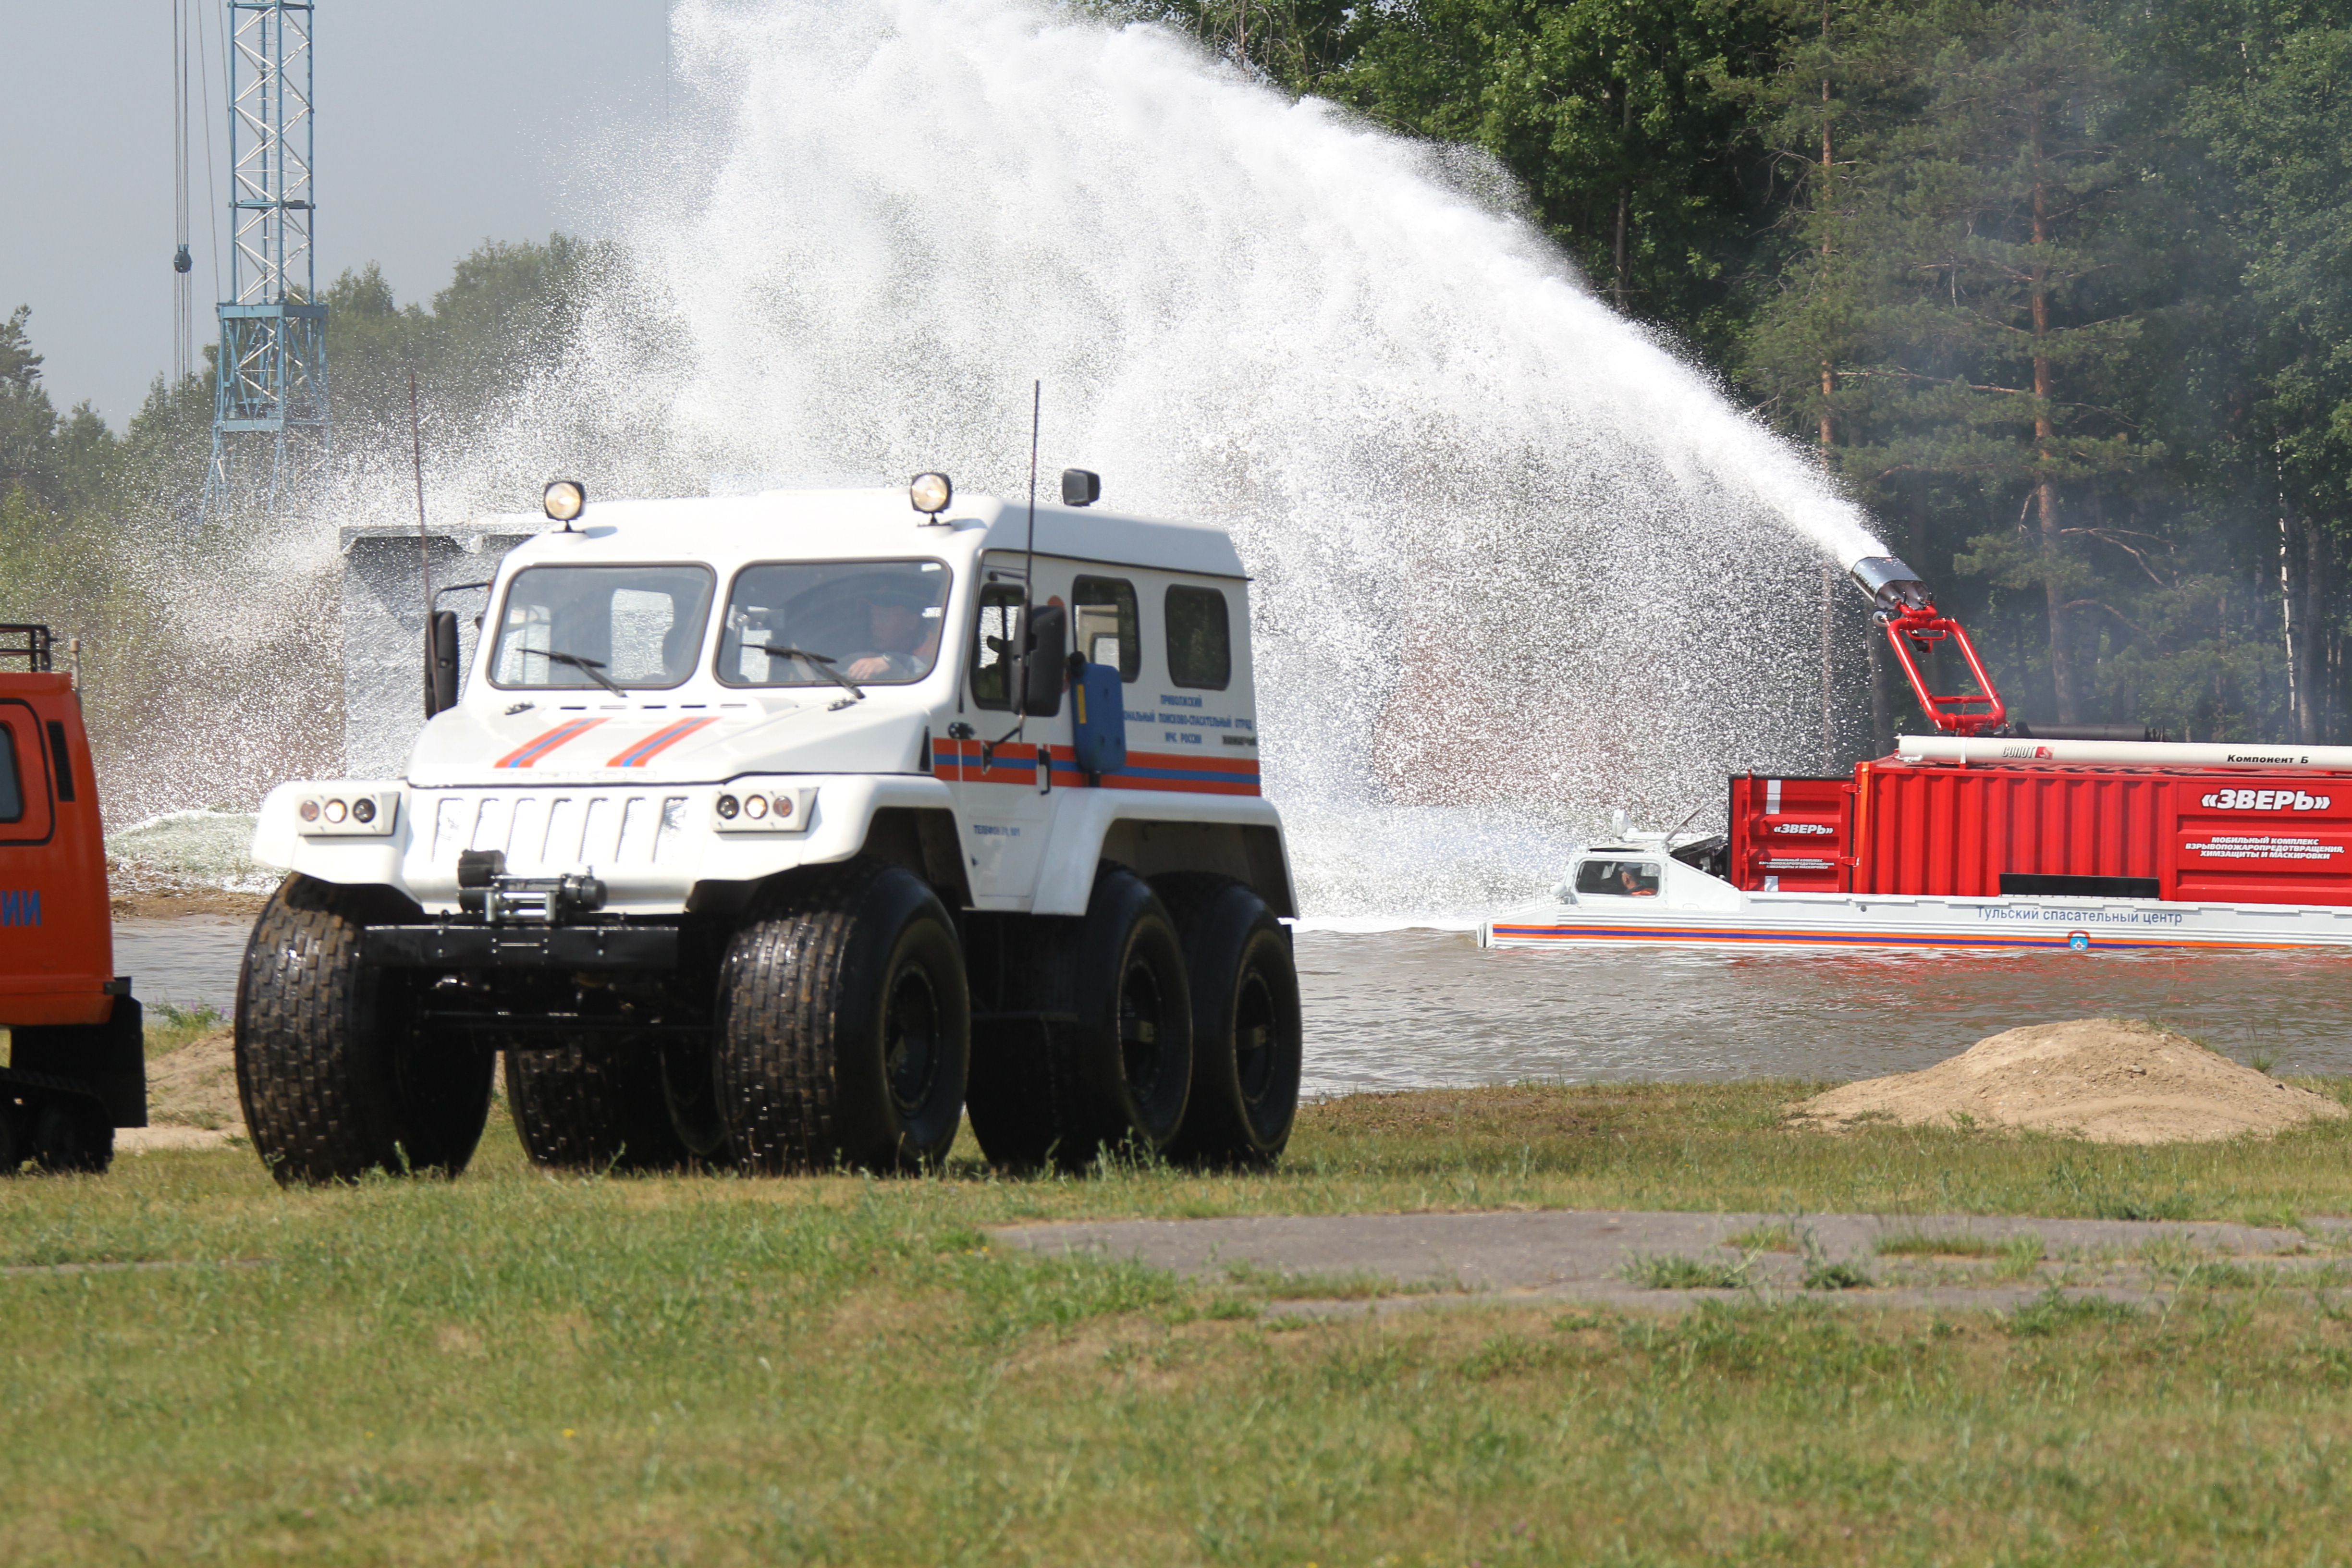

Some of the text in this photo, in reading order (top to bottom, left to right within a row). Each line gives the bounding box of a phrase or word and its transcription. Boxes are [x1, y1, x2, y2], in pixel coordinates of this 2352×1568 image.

[2002, 745, 2035, 759] СОПОТ
[2227, 754, 2294, 763] Компонент
[2201, 789, 2331, 810] «ЗВЕРЬ»
[1773, 823, 1834, 834] «ЗВЕРЬ»
[2185, 843, 2345, 854] ВЗРЫВОПОЖАРОПРЕДОТВРАЩЕНИЯ,
[2200, 850, 2259, 858] ХИМЗАЩИТЫ
[2269, 852, 2330, 860] МАСКИРОВКИ
[1978, 906, 2182, 926] Тульский спасательный центр
